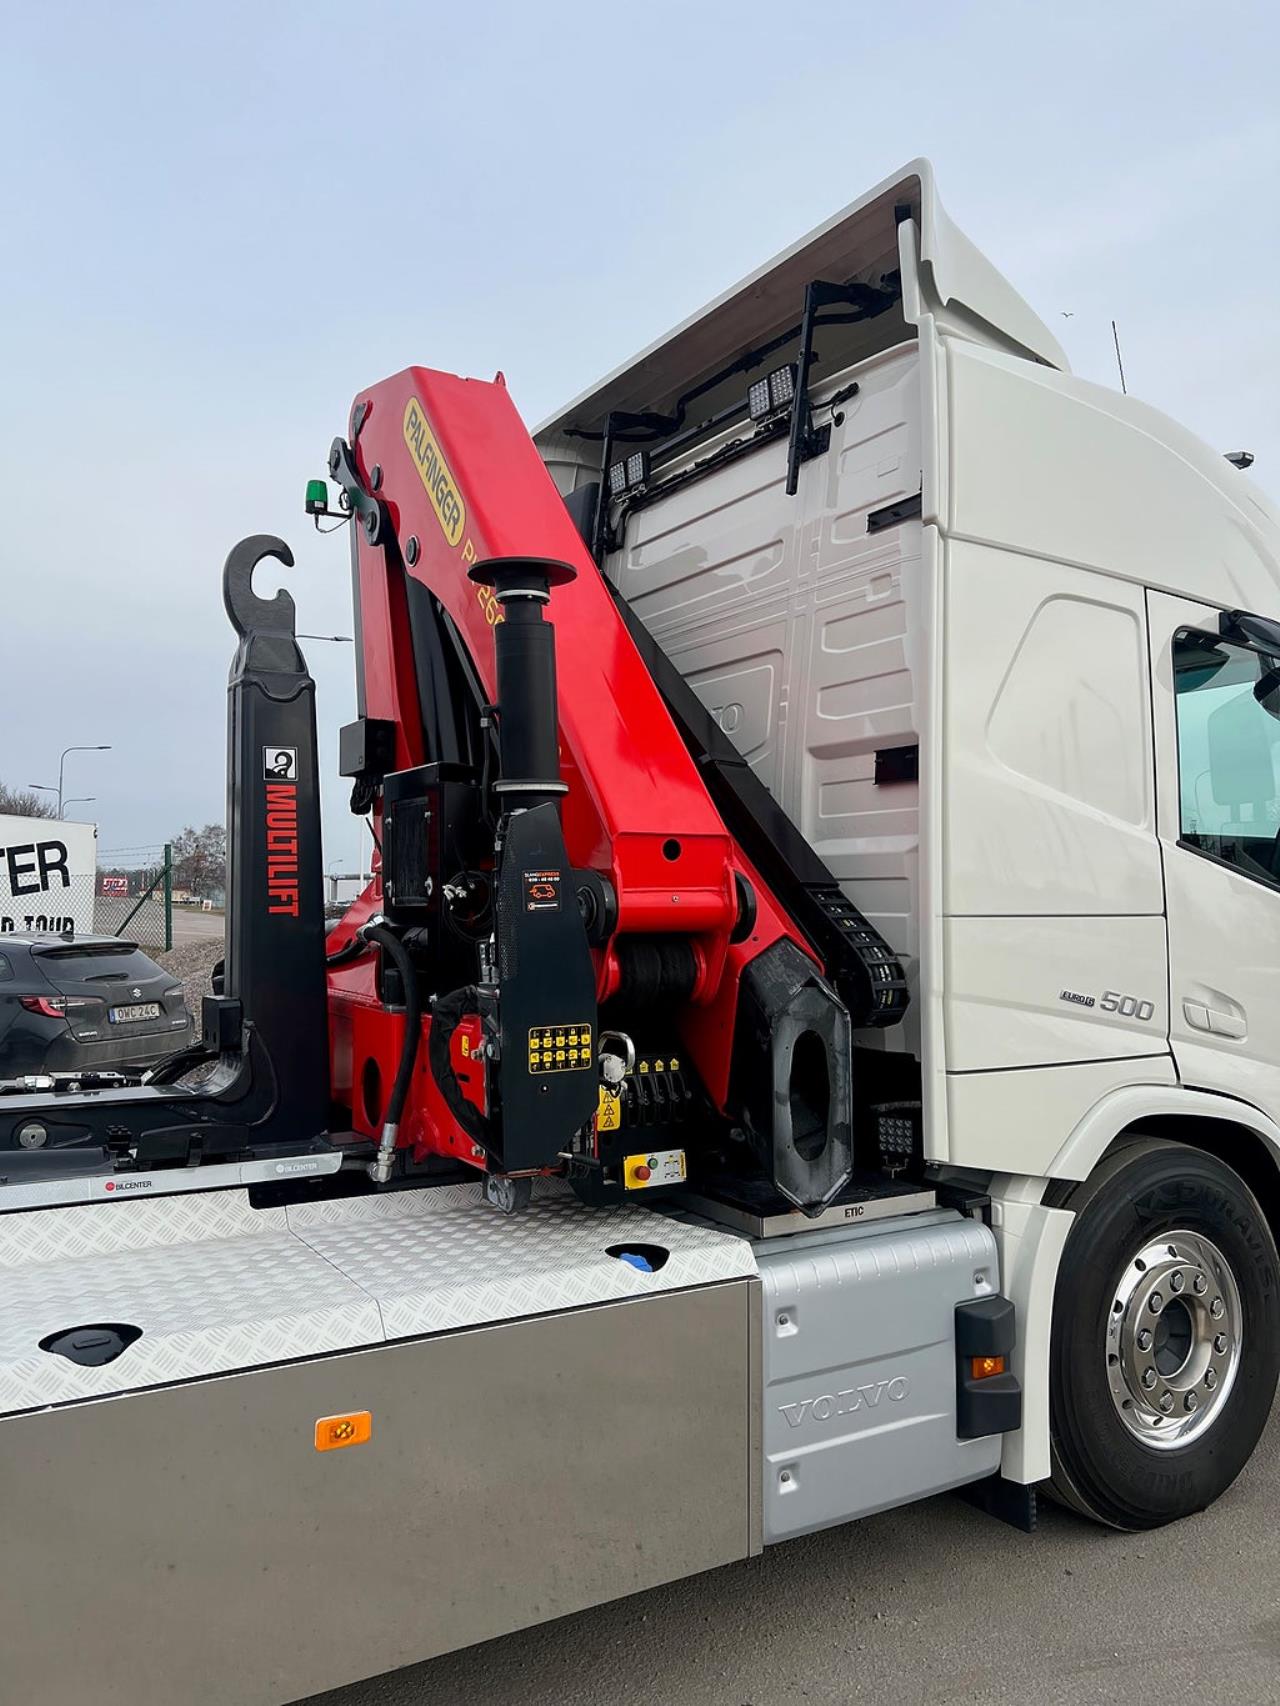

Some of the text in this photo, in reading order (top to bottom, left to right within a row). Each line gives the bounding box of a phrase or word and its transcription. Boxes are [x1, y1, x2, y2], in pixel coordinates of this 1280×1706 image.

[406, 405, 461, 538] PALFINGER
[0, 840, 70, 897] ER
[265, 785, 299, 917] MULTILIFT
[1100, 990, 1155, 1021] 500
[115, 1180, 152, 1191] BILCENTER
[844, 1206, 864, 1218] ETIC
[778, 1377, 911, 1428] VOLVO
